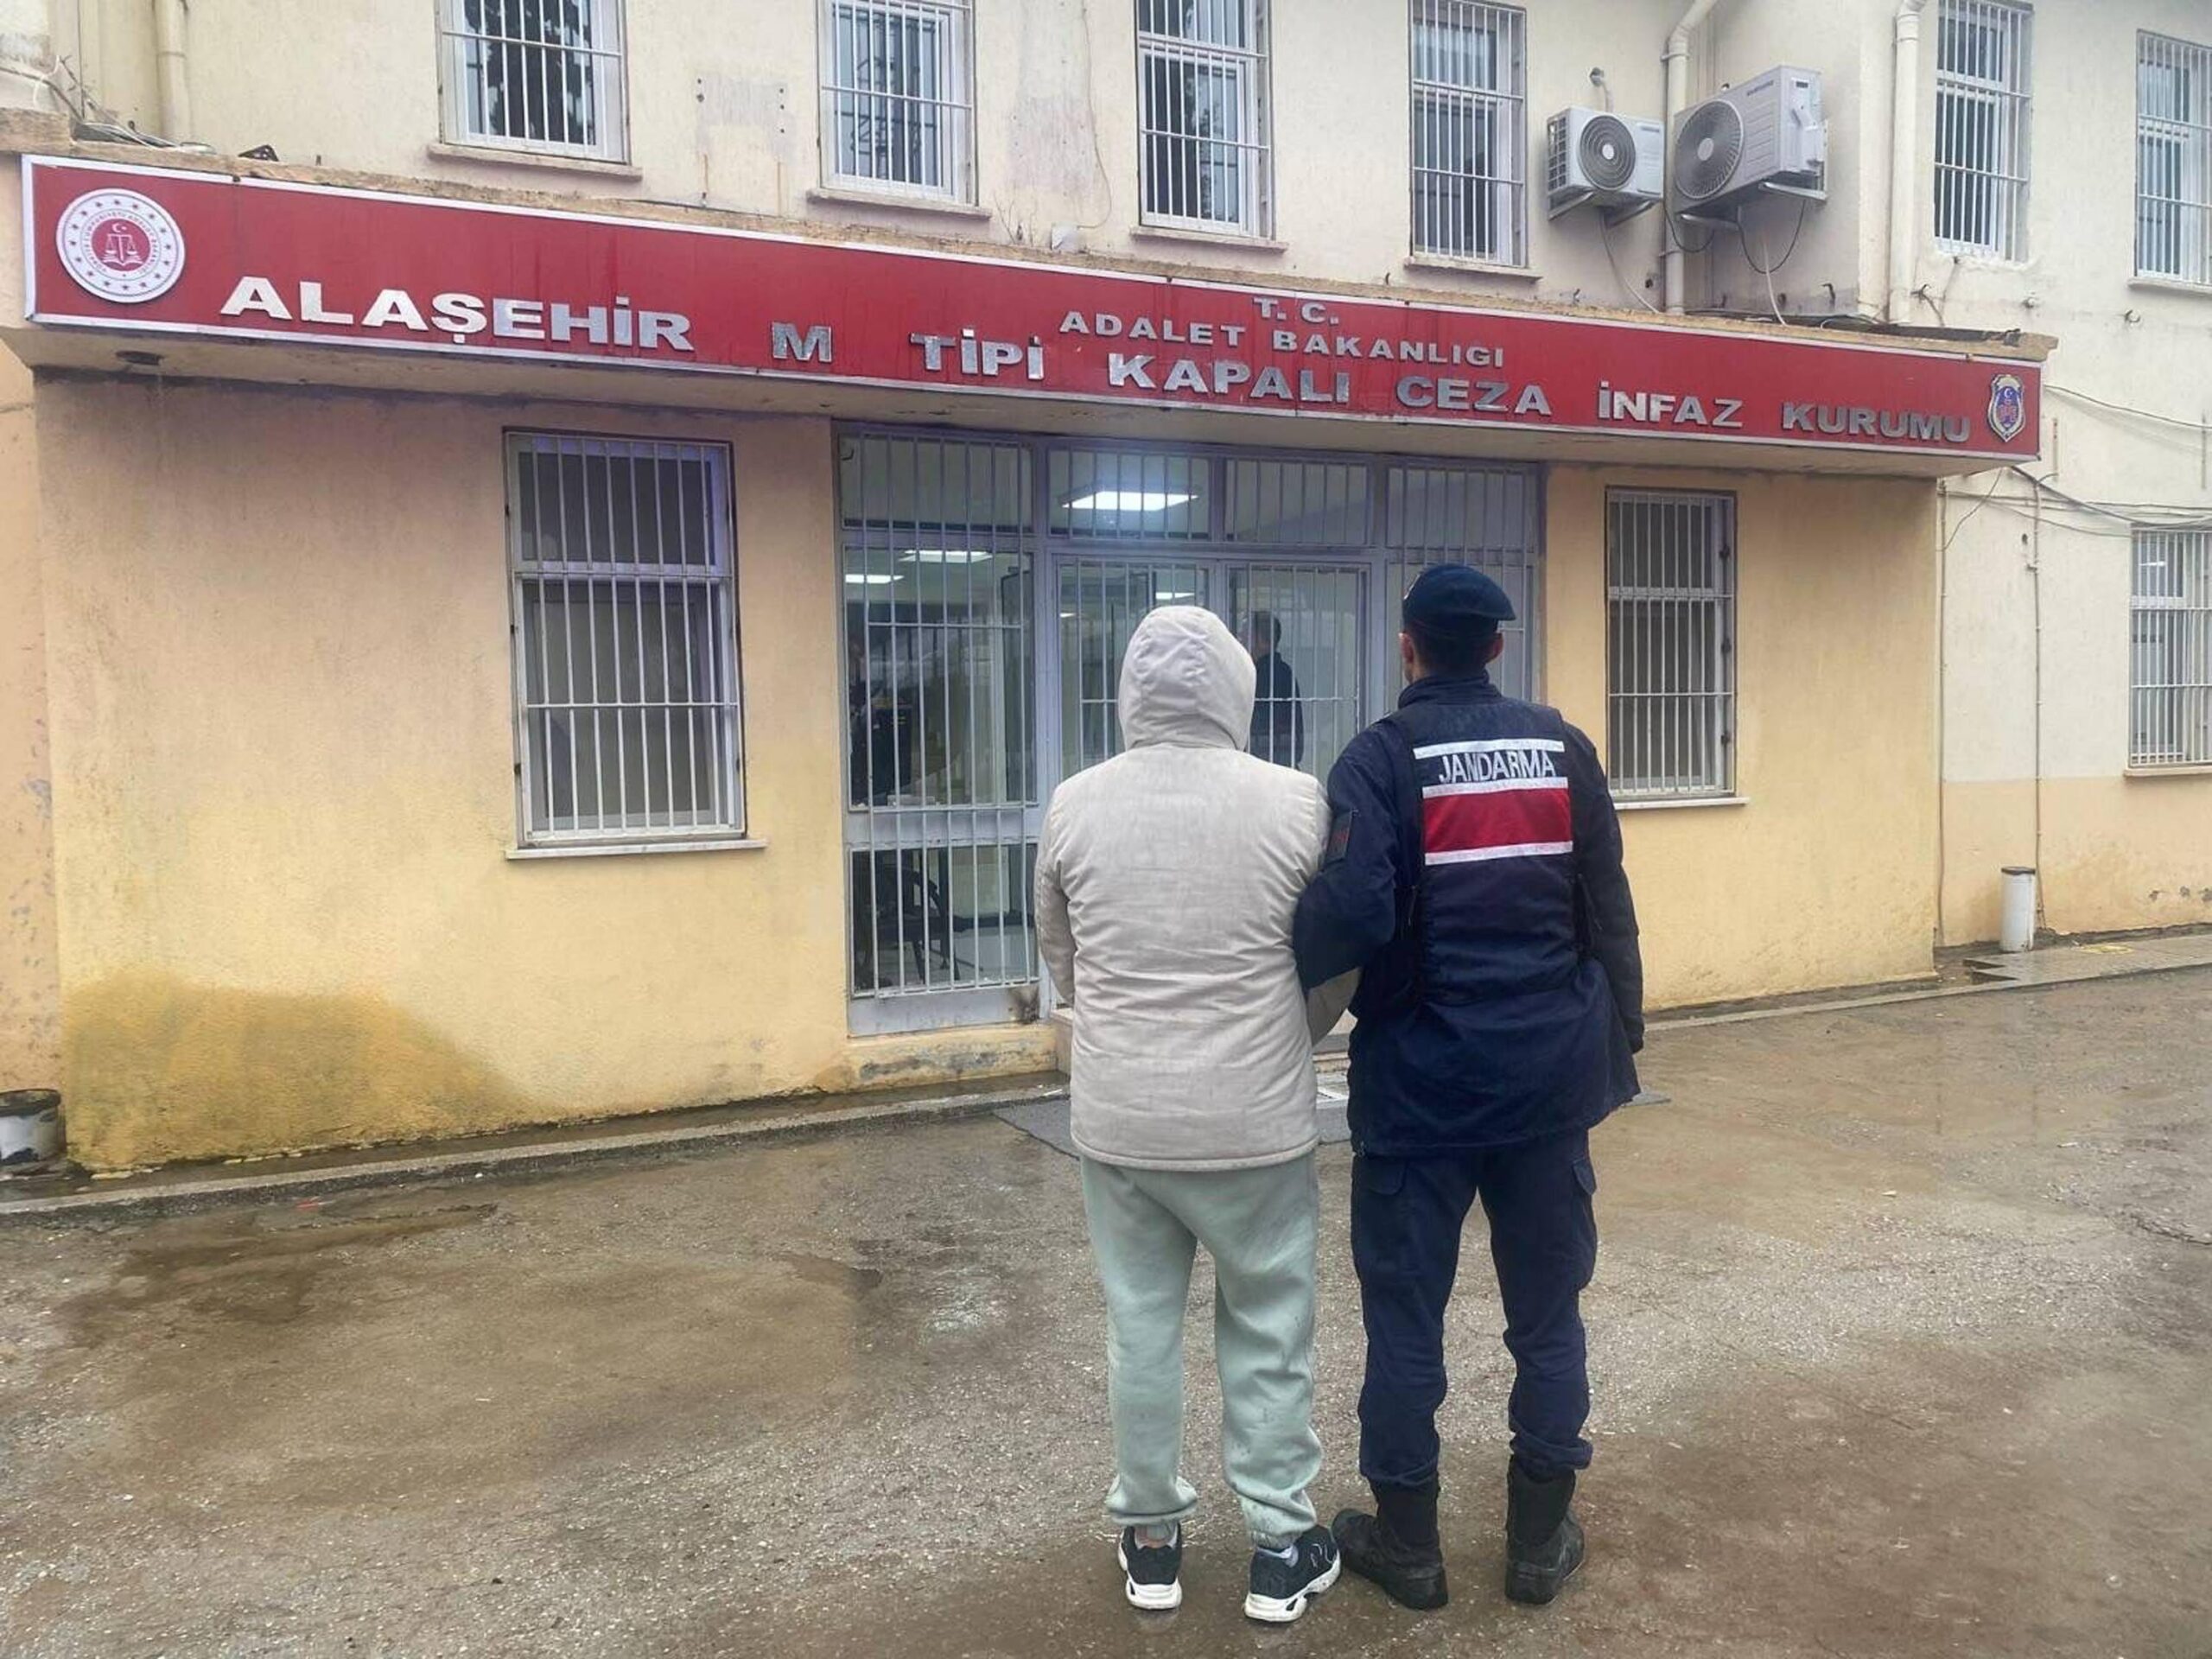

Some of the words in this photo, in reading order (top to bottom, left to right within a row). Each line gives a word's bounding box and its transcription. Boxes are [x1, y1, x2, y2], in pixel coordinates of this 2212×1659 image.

[1058, 311, 1246, 346] ADALET
[221, 276, 694, 351] ALAŞEHİR
[772, 321, 831, 364] M
[909, 327, 1044, 381] TİPİ
[1107, 353, 1351, 404] KAPALI
[1396, 375, 1552, 417] CEZA
[1597, 379, 1745, 427] İNFAZ
[1780, 401, 1970, 442] KURUMU
[1439, 750, 1555, 784] JANDARMA
